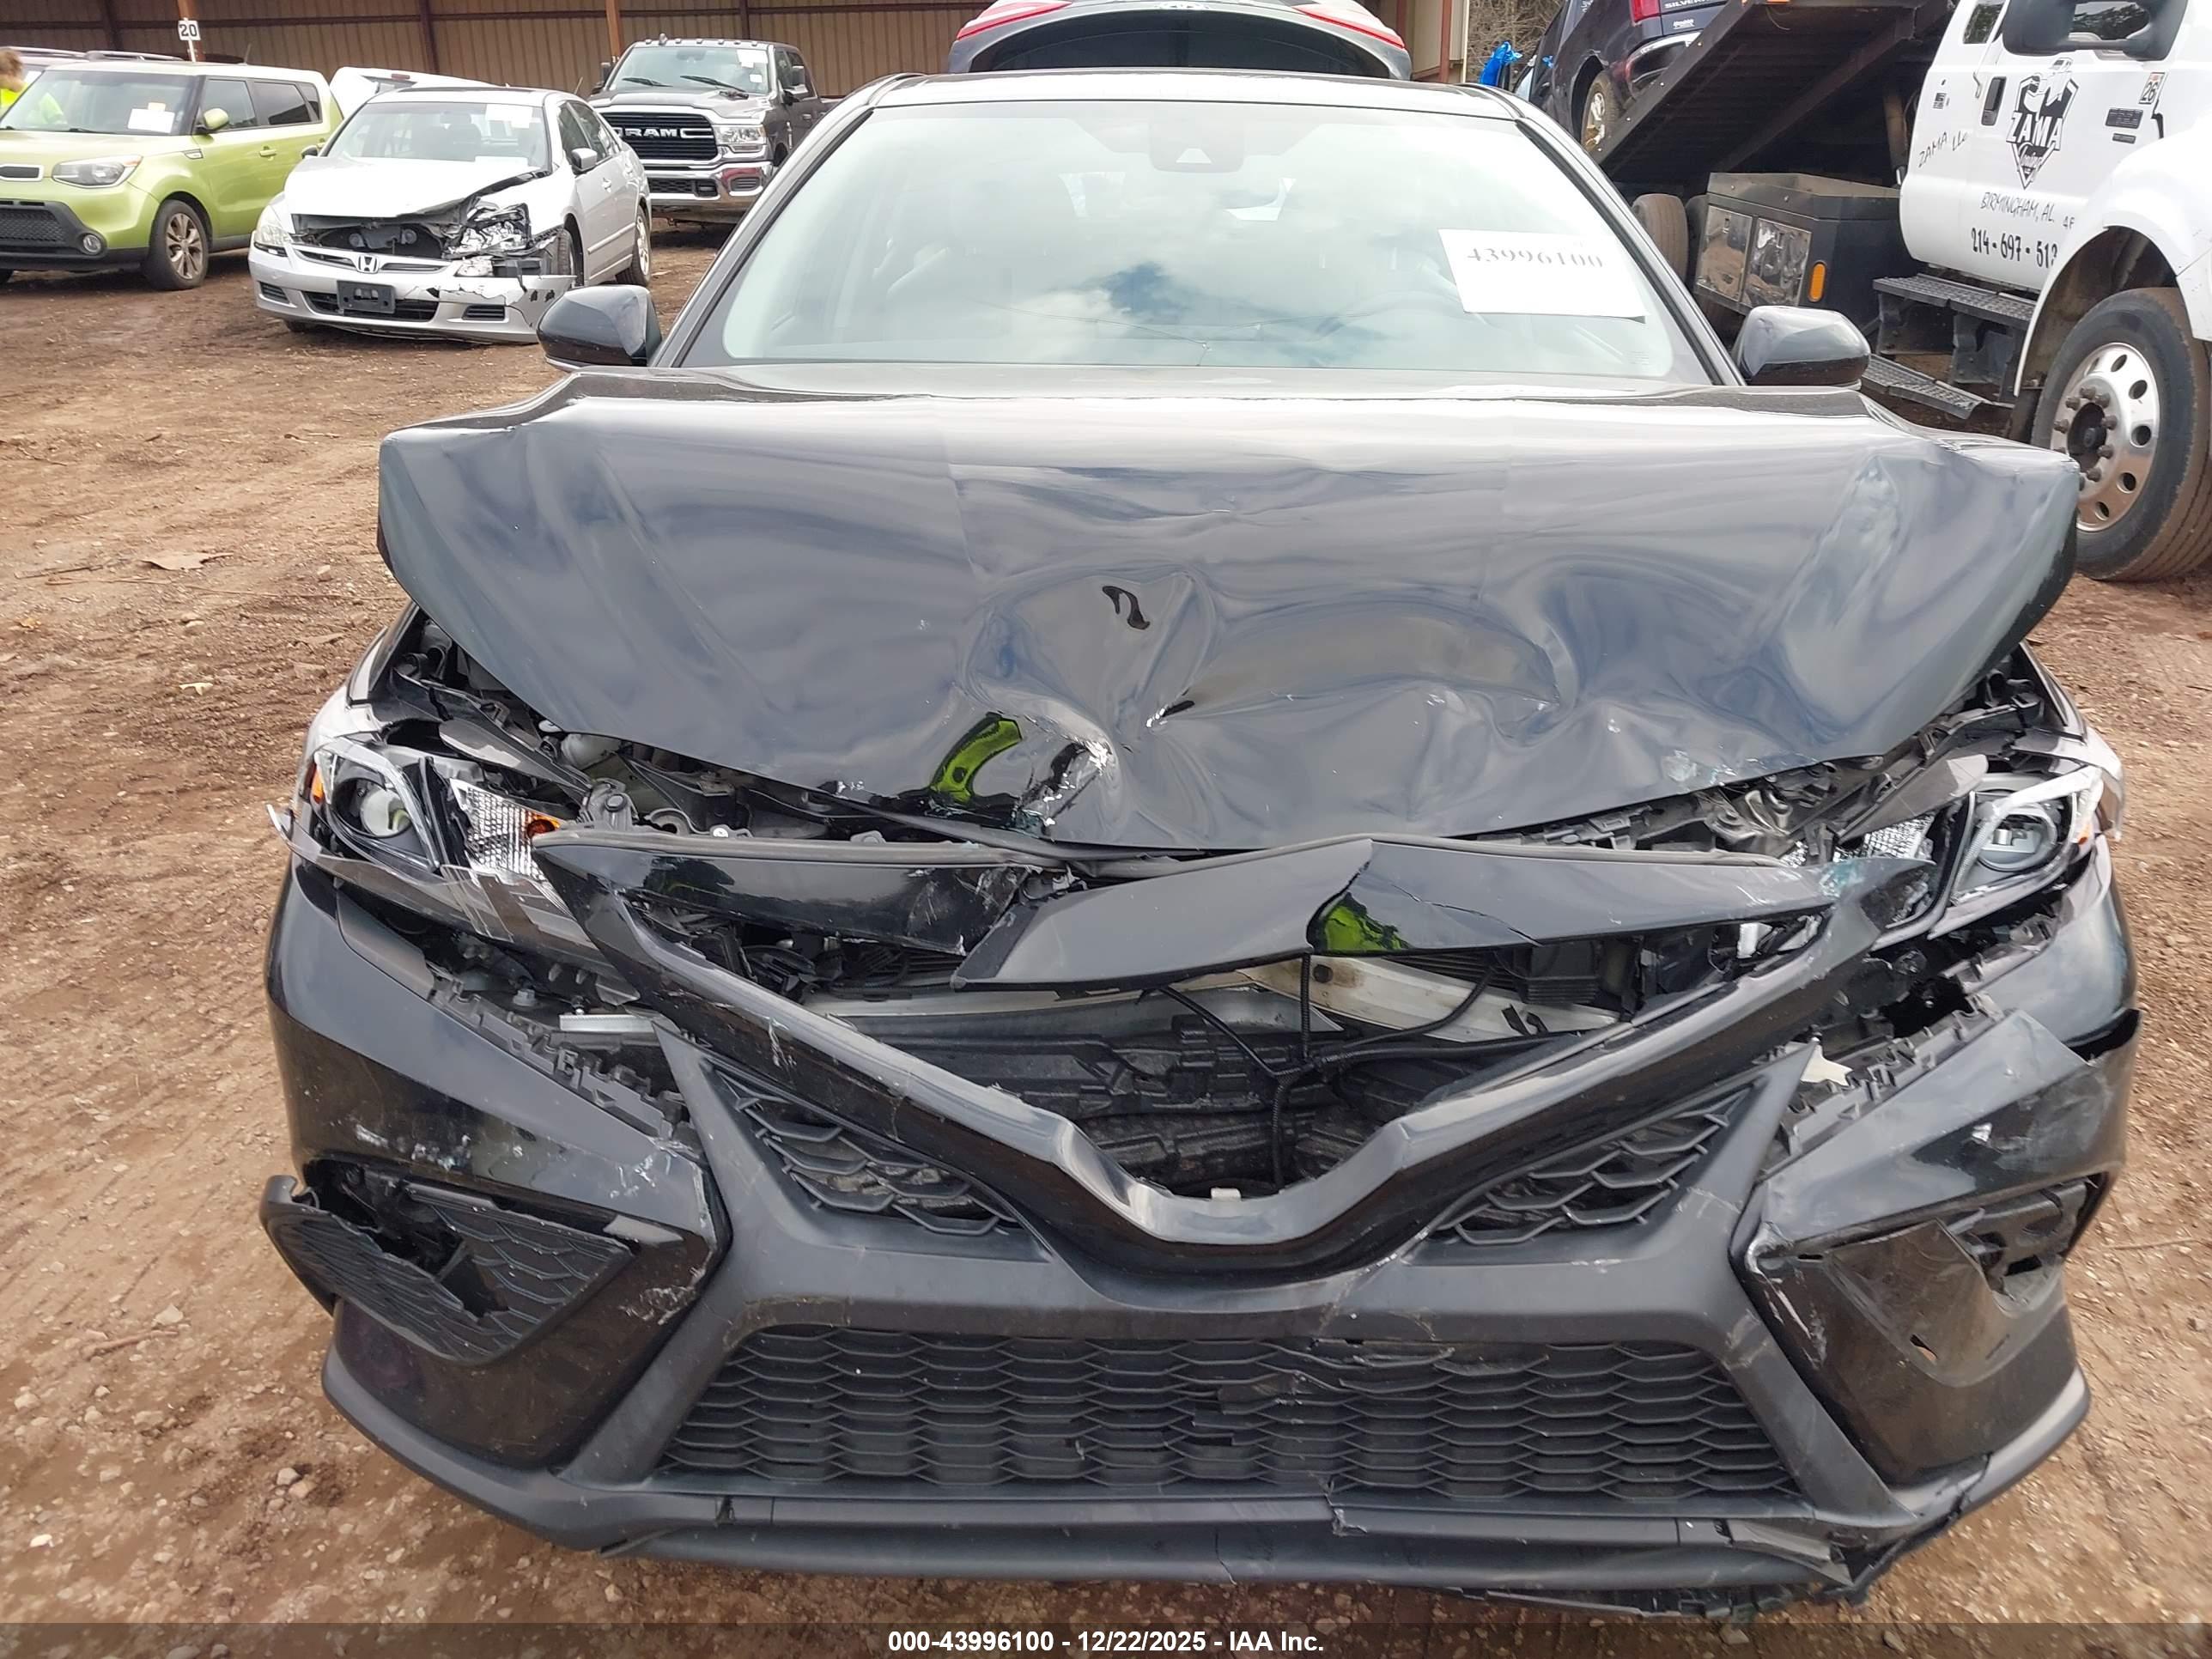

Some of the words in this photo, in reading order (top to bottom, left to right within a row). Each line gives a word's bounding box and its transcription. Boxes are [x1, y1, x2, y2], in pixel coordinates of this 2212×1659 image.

[179, 23, 198, 37] 20
[2141, 81, 2159, 102] 26
[624, 128, 678, 137] RAM
[2006, 111, 2063, 151] ZAMA
[1917, 131, 1948, 168] ZAMA
[1467, 247, 1604, 268] 43996100
